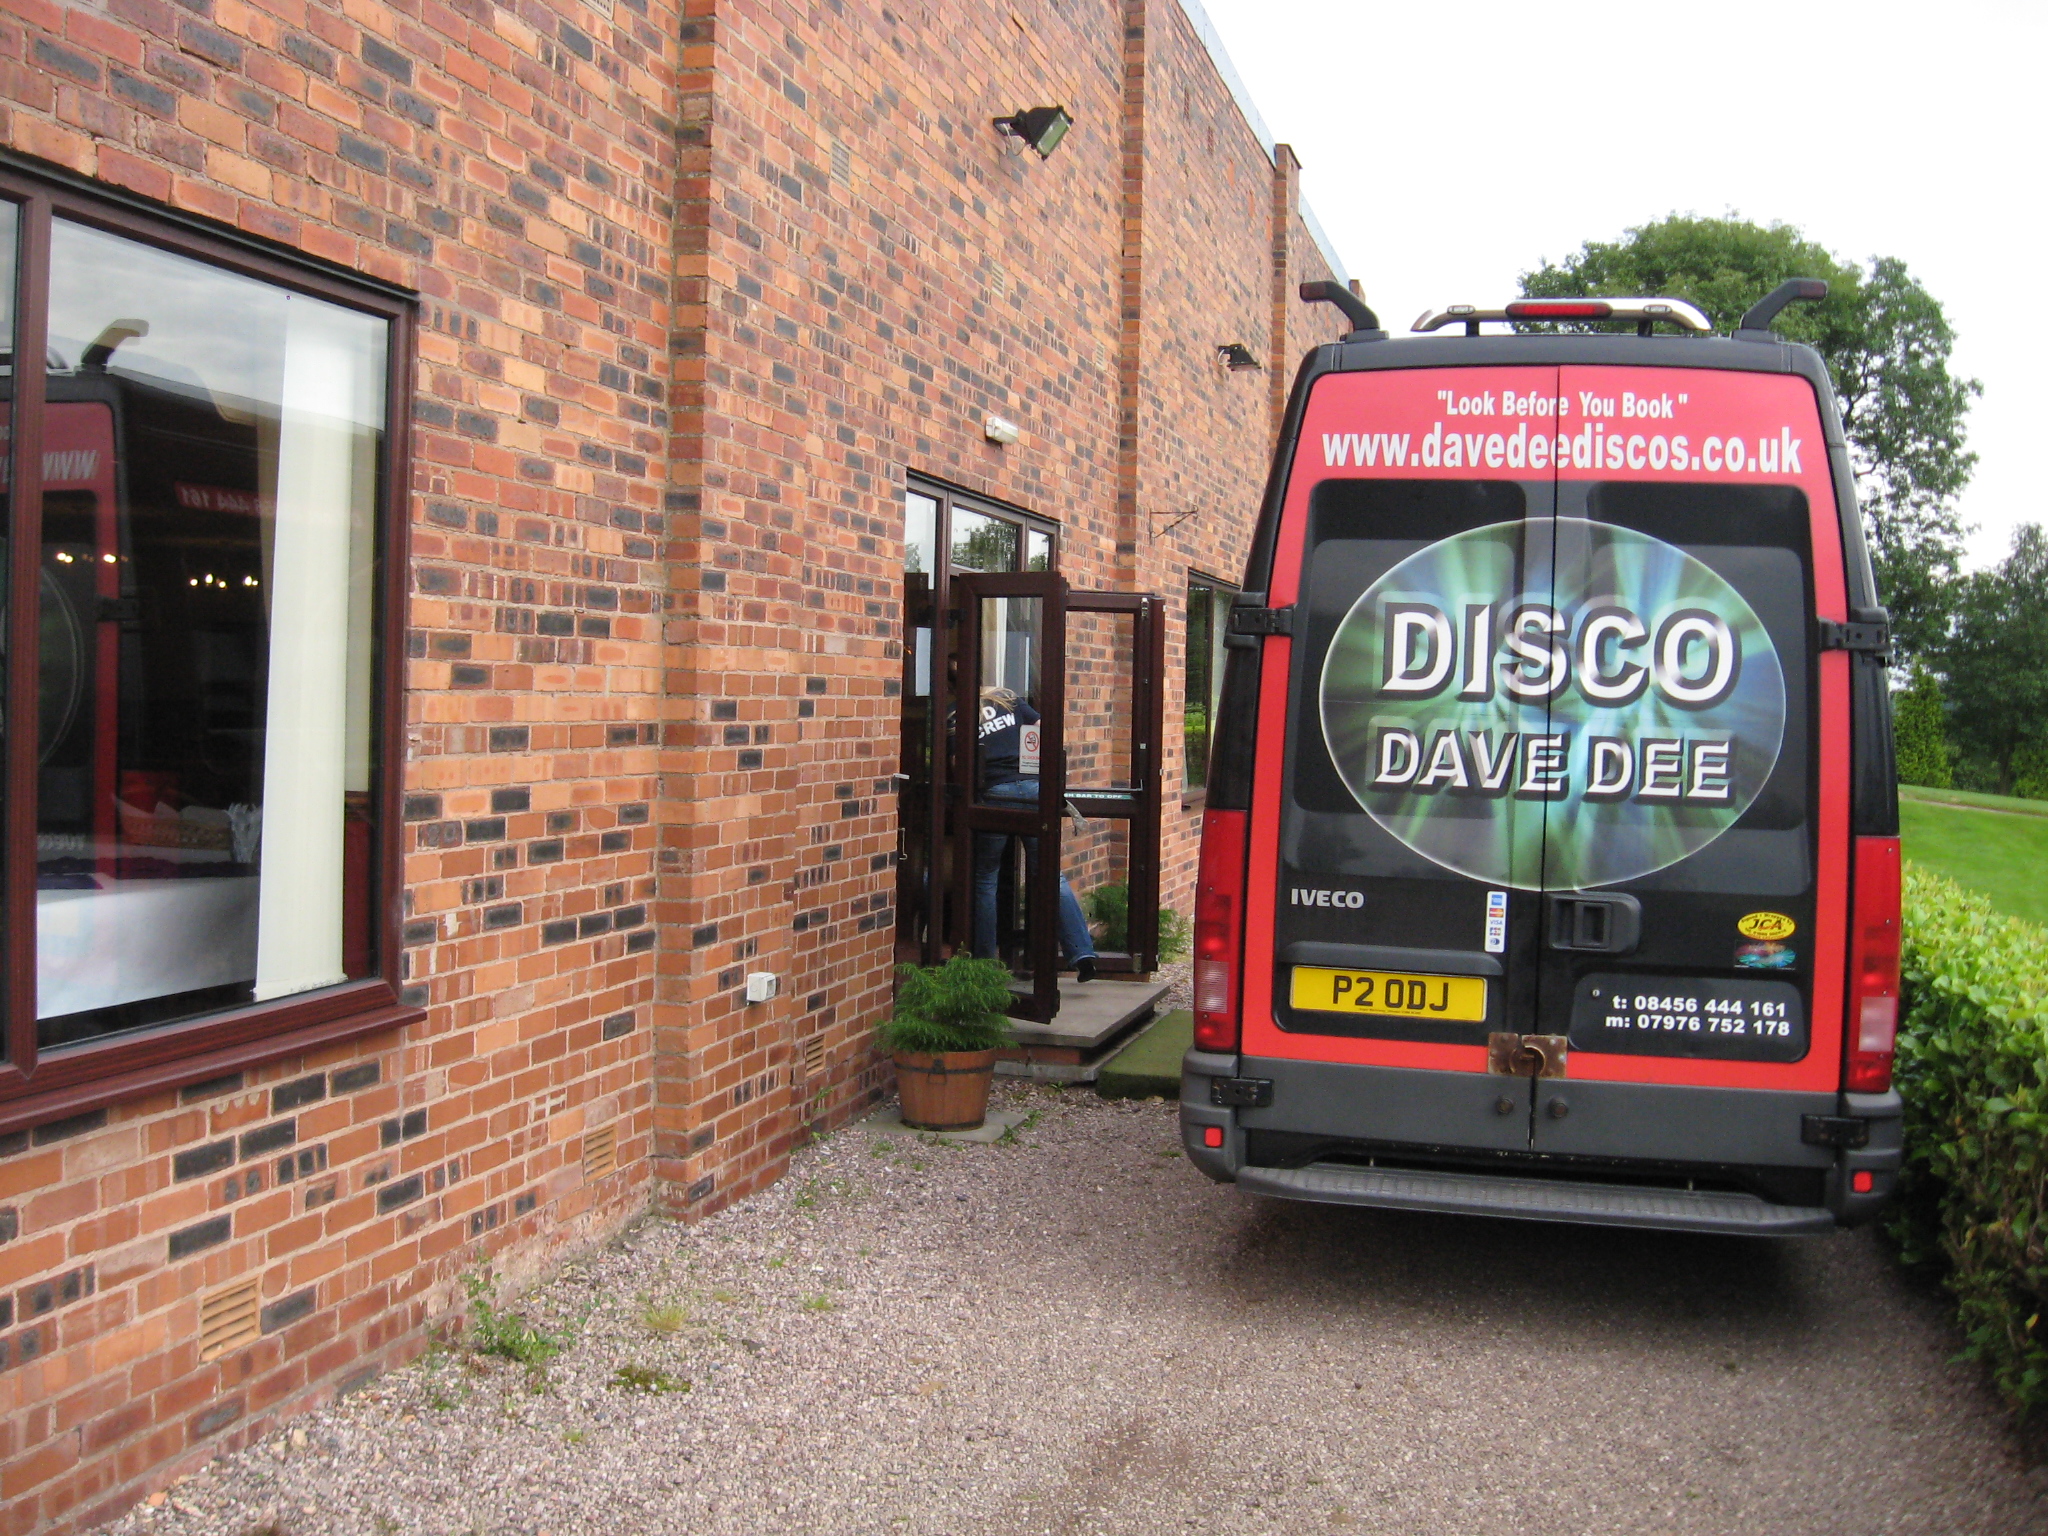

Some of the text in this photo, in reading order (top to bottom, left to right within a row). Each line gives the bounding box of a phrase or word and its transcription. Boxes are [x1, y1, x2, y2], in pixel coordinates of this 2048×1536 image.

[1437, 390, 1496, 416] "Look
[1502, 390, 1570, 417] Before
[1578, 391, 1615, 417] You
[1321, 421, 1802, 475] www.davedeediscos.co.uk
[1378, 603, 1740, 707] DISCO
[1371, 727, 1733, 802] DAVE DEE
[1291, 888, 1365, 909] IVECO
[1749, 919, 1782, 930] JCA
[1332, 975, 1375, 1007] P2
[1612, 995, 1786, 1017] t: 08456 444 161
[1605, 1014, 1790, 1036] m: 07976 752 178
